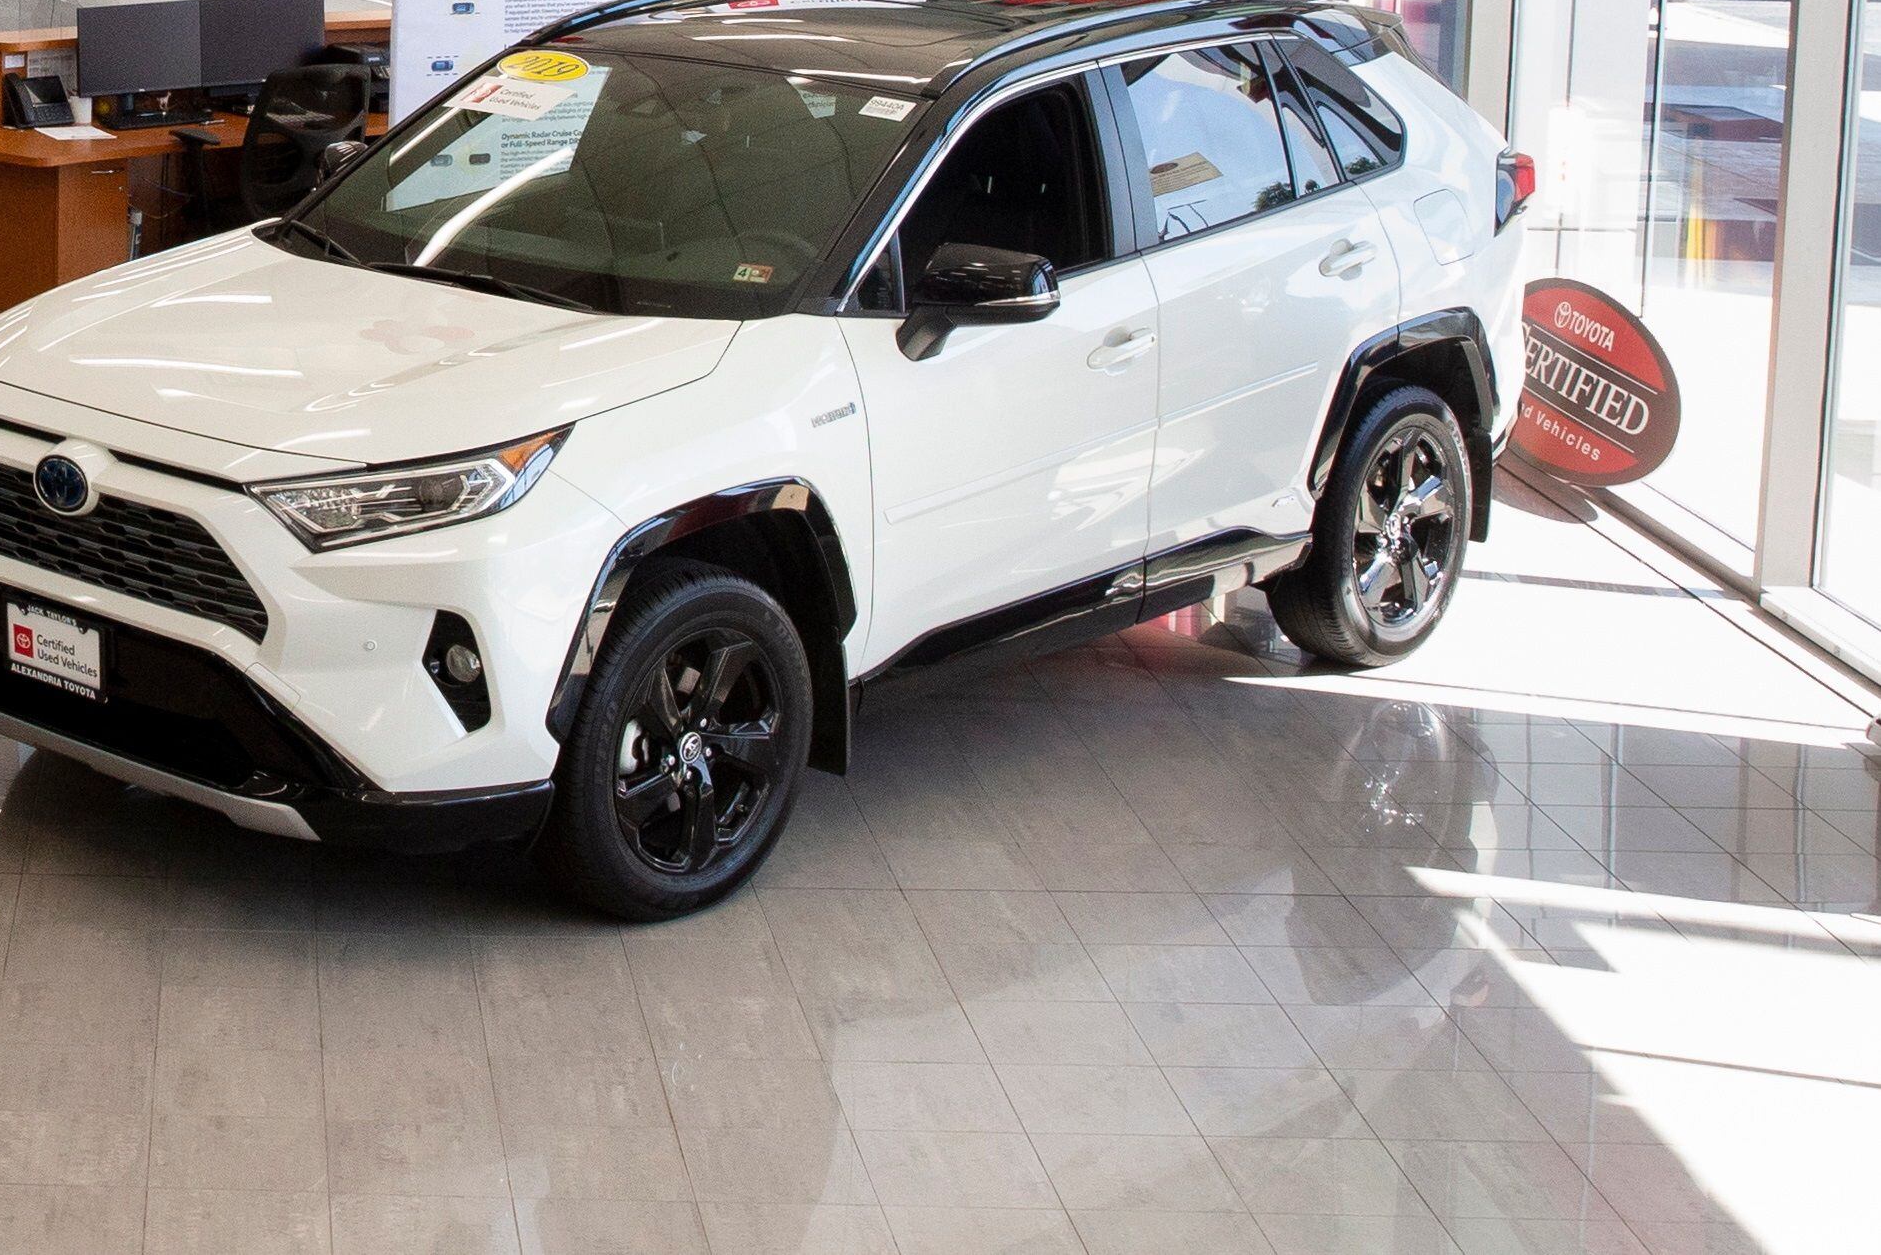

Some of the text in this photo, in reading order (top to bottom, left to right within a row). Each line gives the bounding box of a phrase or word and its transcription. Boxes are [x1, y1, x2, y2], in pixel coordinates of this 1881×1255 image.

[504, 56, 580, 77] 2019
[531, 130, 551, 138] Radar
[552, 130, 572, 138] Cruise
[547, 137, 568, 147] Range
[1569, 311, 1616, 352] TOYOTA
[1536, 410, 1601, 462] Vehicles
[36, 634, 76, 656] Certified
[37, 649, 98, 678] Used Vehicles
[11, 662, 96, 700] ALEXANDRIA TOYOTA
